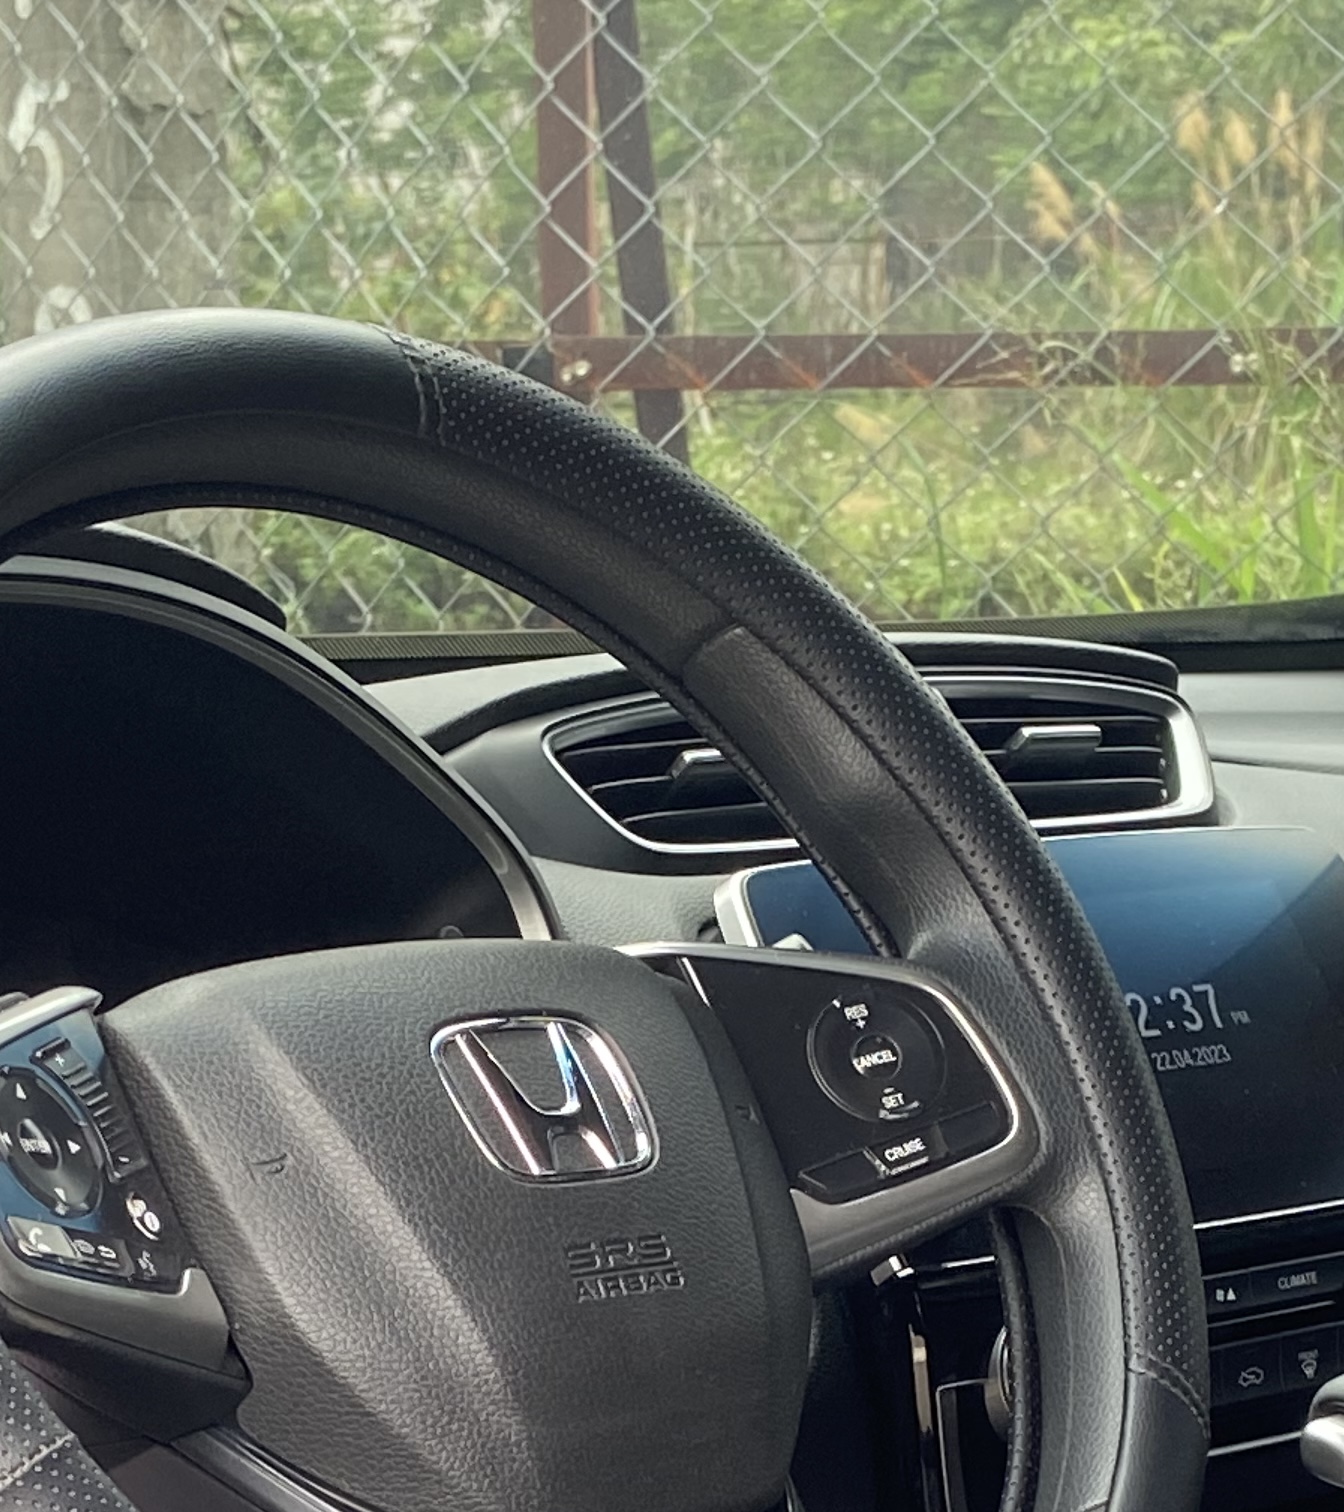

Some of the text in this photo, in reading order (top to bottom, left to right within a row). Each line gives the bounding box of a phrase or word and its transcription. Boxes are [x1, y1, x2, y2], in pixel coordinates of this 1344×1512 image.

[844, 1003, 869, 1020] RES
[853, 1049, 897, 1071] CANCEL
[881, 1092, 905, 1109] SET
[884, 1137, 926, 1161] CRUISE
[567, 1234, 672, 1275] SRS
[576, 1270, 685, 1303] AIRBAG
[1277, 1271, 1318, 1291] CLIMATE
